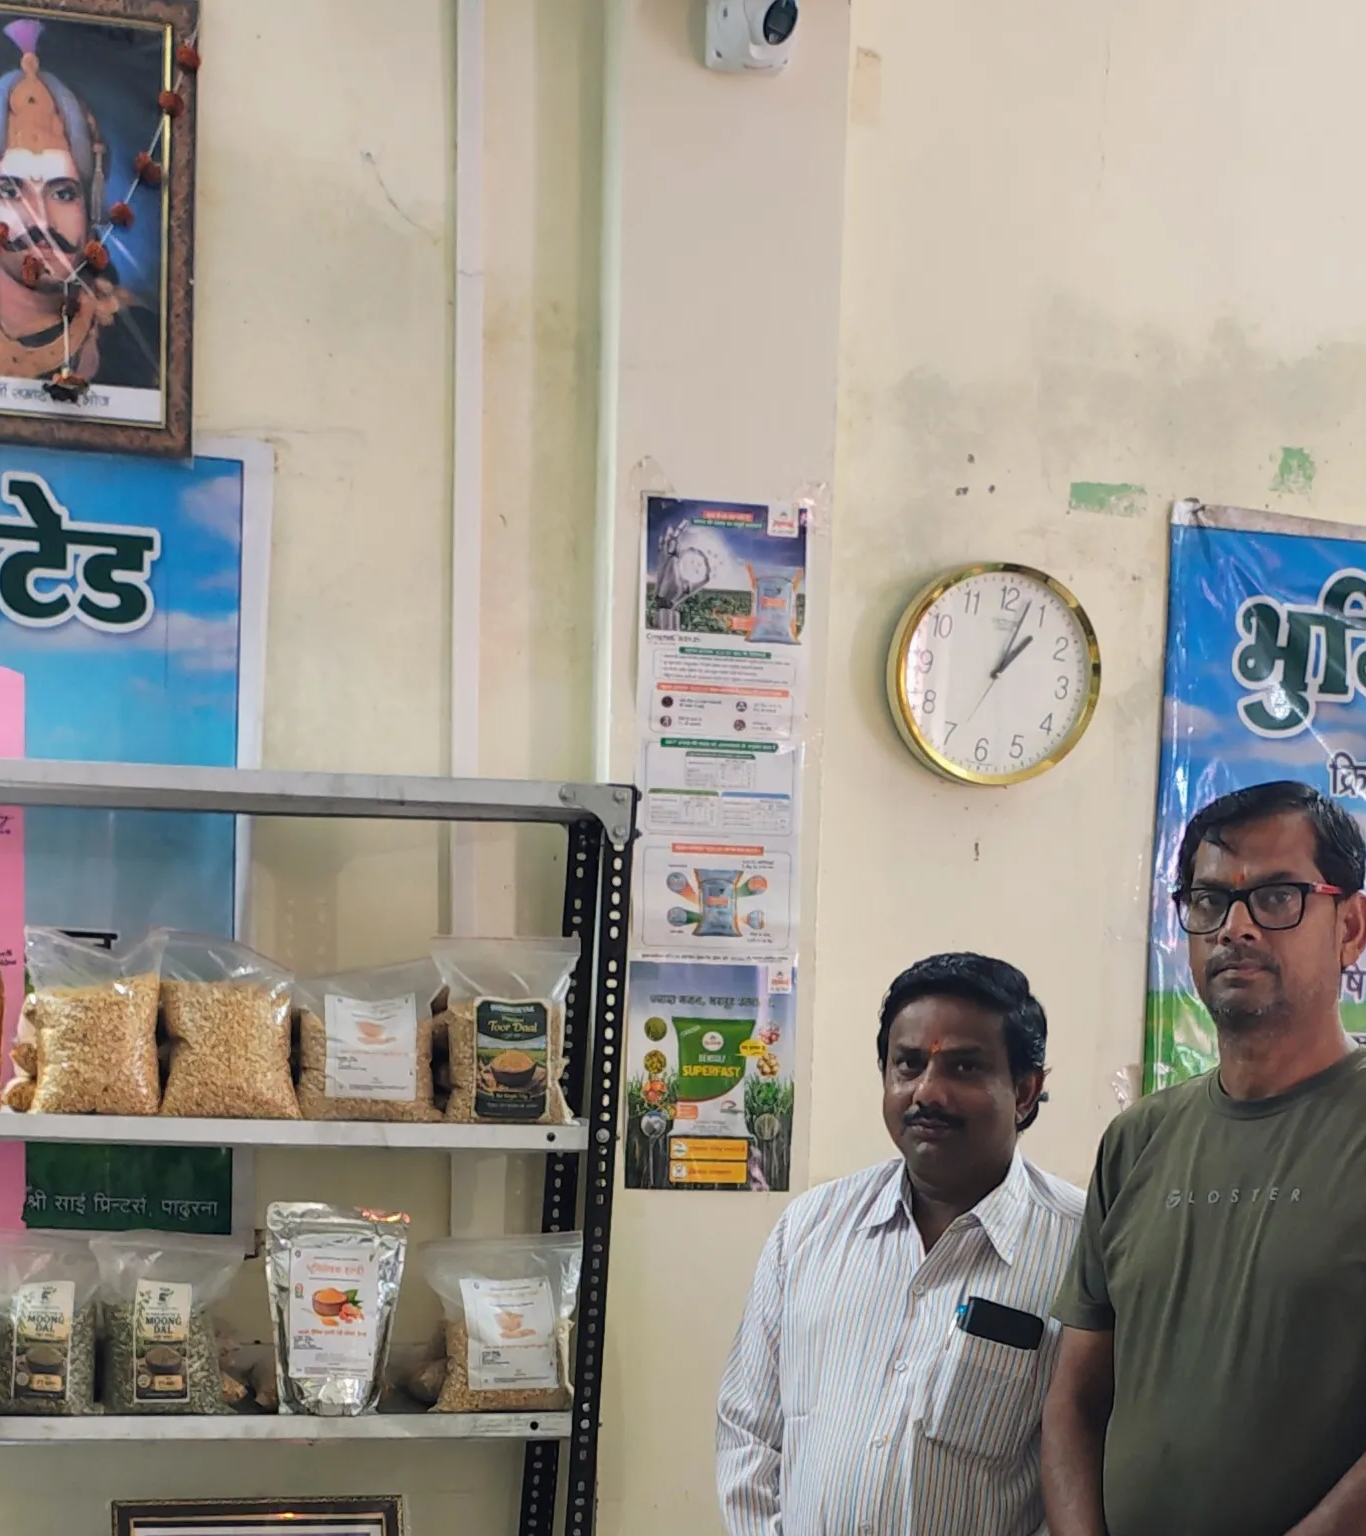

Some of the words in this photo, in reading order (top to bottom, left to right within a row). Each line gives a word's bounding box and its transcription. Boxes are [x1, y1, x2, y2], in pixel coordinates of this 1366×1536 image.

[963, 588, 982, 617] 11
[1000, 584, 1022, 613] 12
[934, 613, 954, 640] 10
[1038, 603, 1047, 629] 1
[919, 648, 934, 674] 9
[1052, 636, 1070, 663] 2
[1054, 675, 1069, 701] 3
[920, 689, 938, 715] 8
[942, 720, 959, 746] 7
[1039, 712, 1054, 737] 4
[973, 737, 990, 763] 6
[1008, 734, 1025, 760] 5
[487, 1020, 512, 1033] Toor
[513, 1022, 538, 1034] Daal
[682, 1065, 742, 1078] SUPERFAST
[1166, 1187, 1302, 1210] GLOSTER
[27, 1313, 65, 1324] MOONG
[35, 1323, 55, 1333] DAL
[145, 1315, 182, 1326] MOONG
[153, 1325, 174, 1334] DAL
